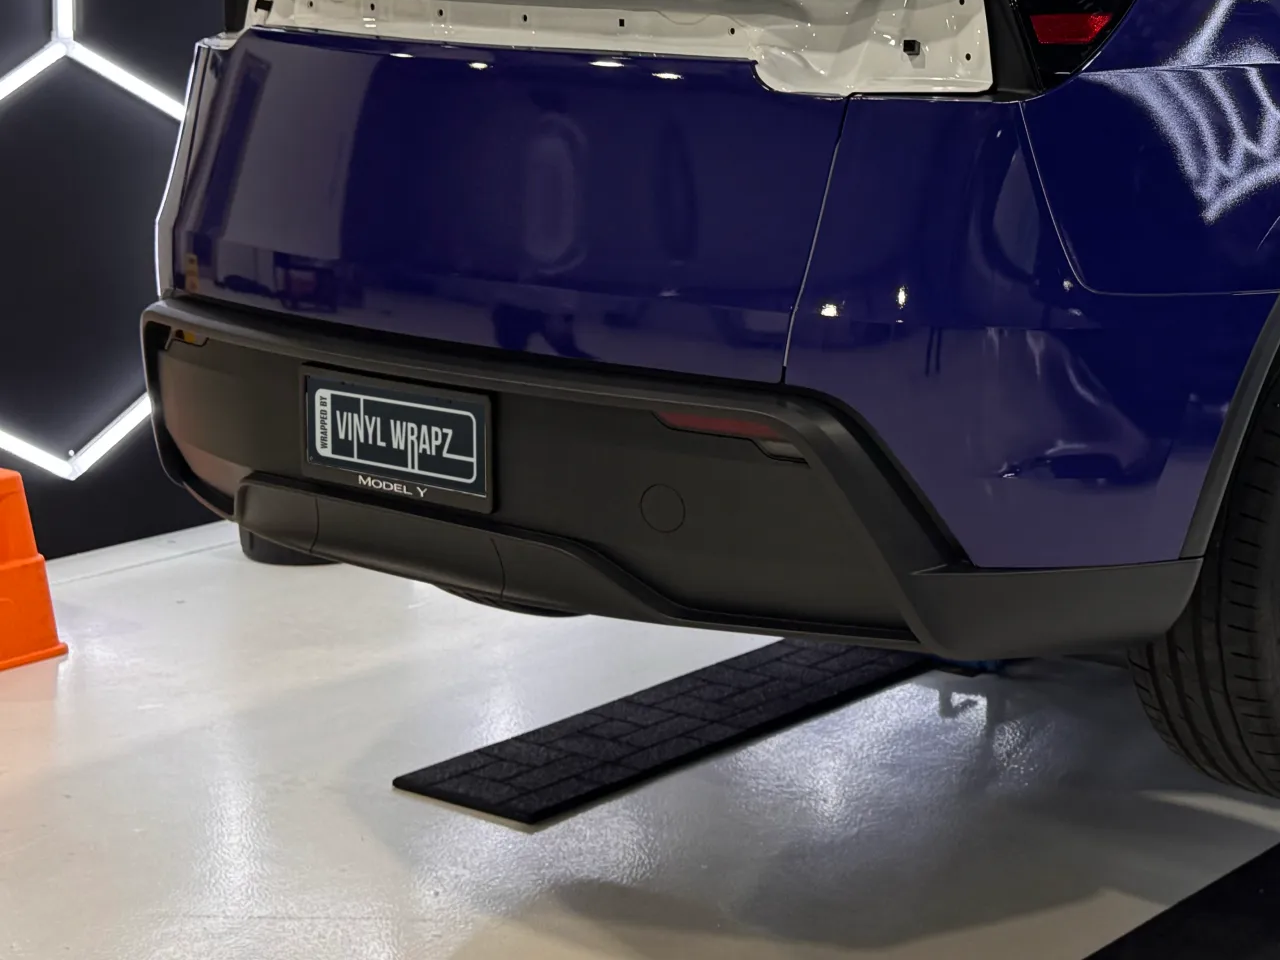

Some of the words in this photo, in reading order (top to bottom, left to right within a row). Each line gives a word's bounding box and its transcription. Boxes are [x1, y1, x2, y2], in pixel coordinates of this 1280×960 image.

[319, 395, 328, 407] BY
[319, 409, 329, 450] WRAPPED
[335, 407, 387, 457] VINYL
[389, 418, 455, 467] WRAPZ
[357, 474, 413, 496] MODEL
[416, 486, 428, 498] Y
